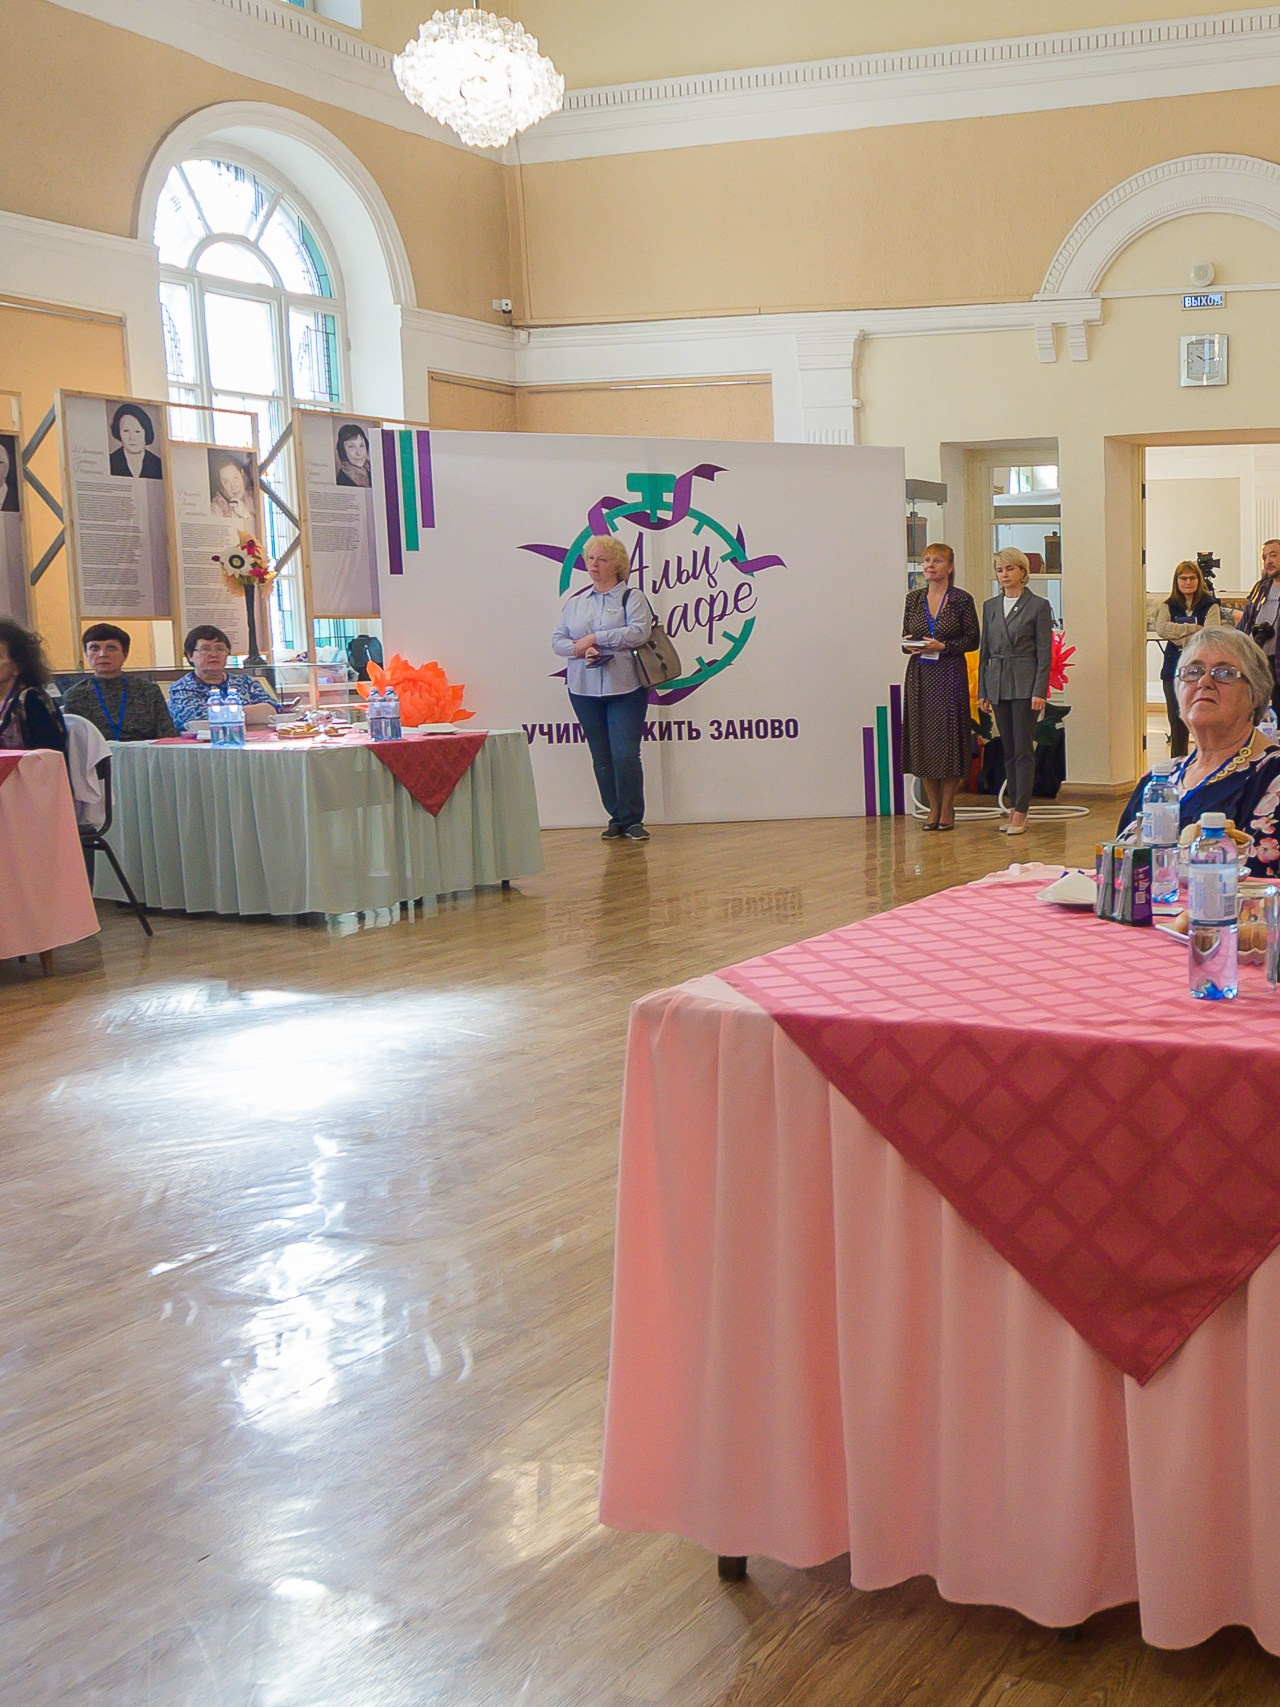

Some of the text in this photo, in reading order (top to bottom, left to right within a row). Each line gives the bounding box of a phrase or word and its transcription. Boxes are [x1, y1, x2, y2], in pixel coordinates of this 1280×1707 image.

[1185, 295, 1222, 307] ВЫХОД
[625, 531, 719, 594] Альц
[667, 582, 758, 645] афе
[521, 722, 587, 744] УЧИМ
[709, 718, 799, 740] ЗАНОВО
